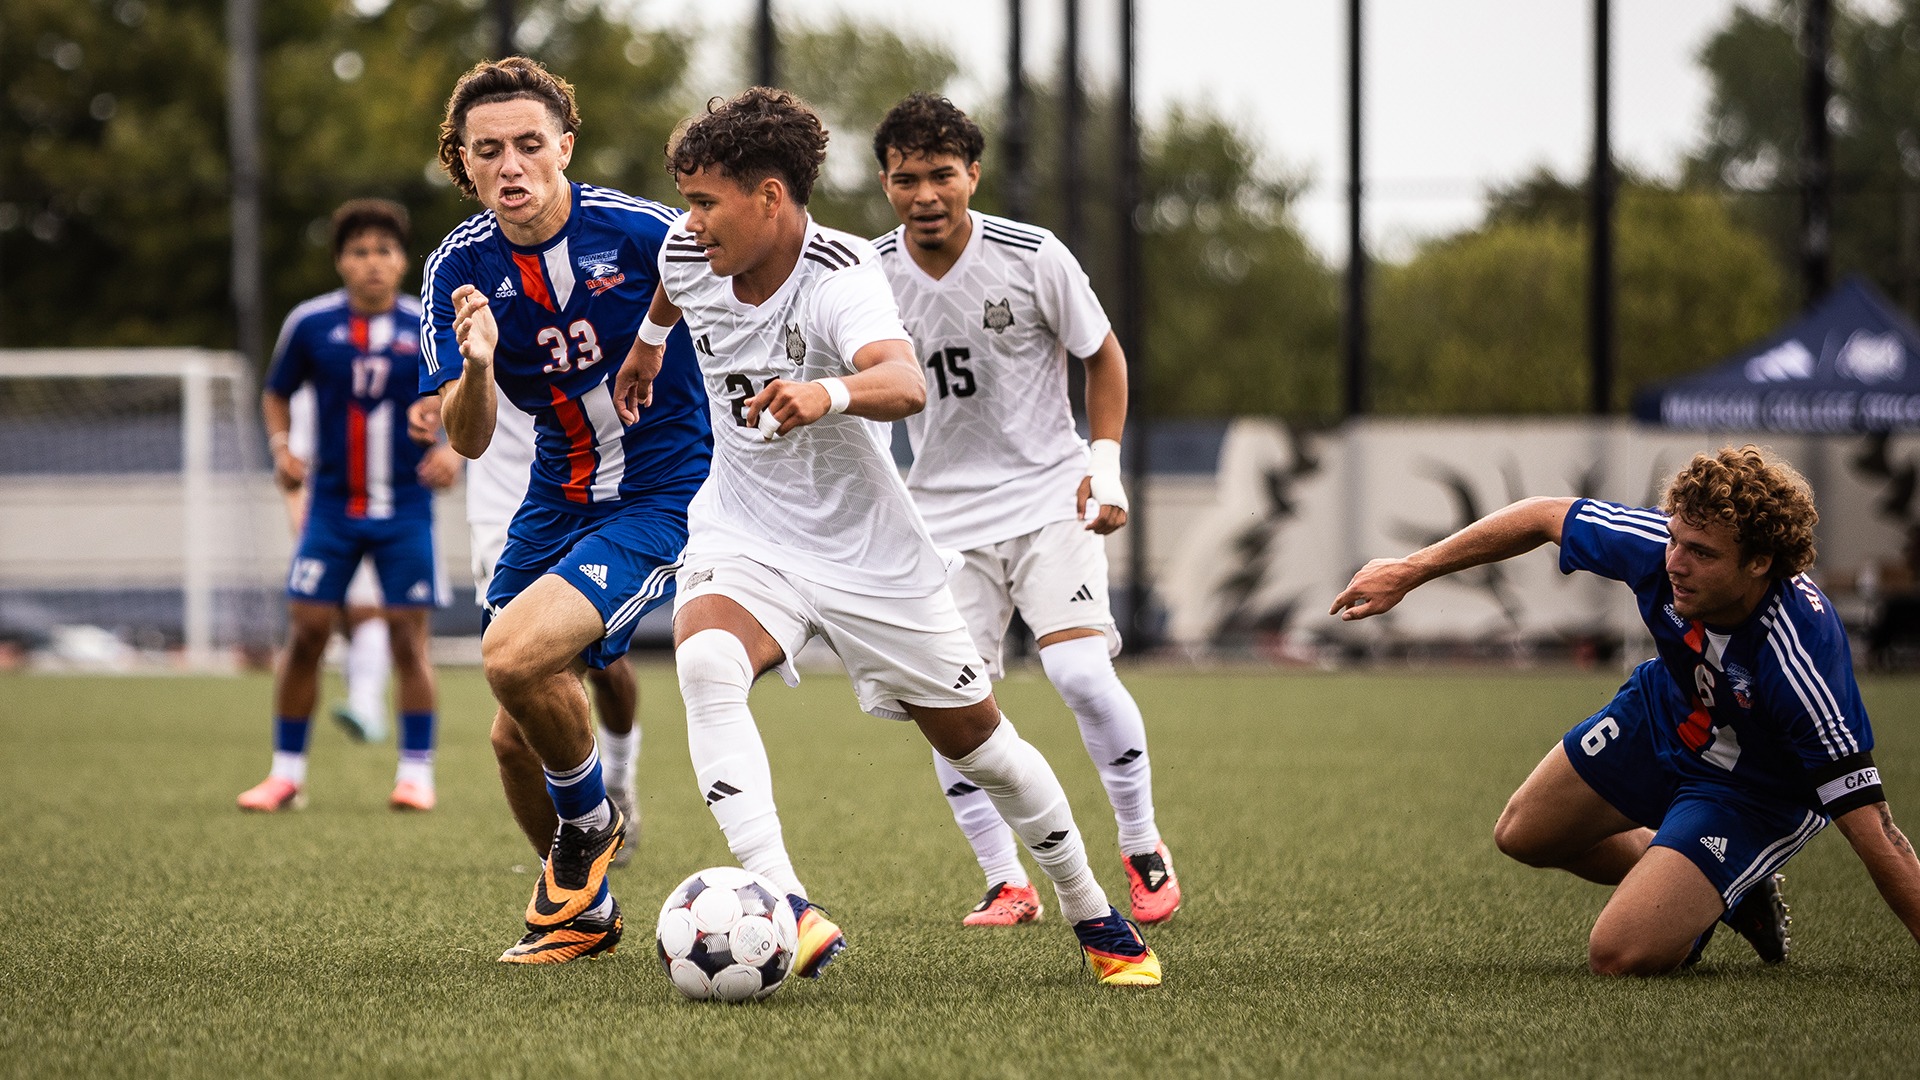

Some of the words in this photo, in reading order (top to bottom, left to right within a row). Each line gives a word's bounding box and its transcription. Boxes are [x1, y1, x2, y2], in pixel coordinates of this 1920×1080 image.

[495, 289, 517, 298] adas
[537, 319, 603, 373] 33
[351, 356, 391, 398] 17
[926, 347, 976, 400] 15
[725, 374, 780, 429] 2
[579, 564, 608, 590] adidas
[1663, 604, 1684, 628] adidas
[1580, 716, 1620, 756] 6
[1700, 836, 1726, 863] adidas
